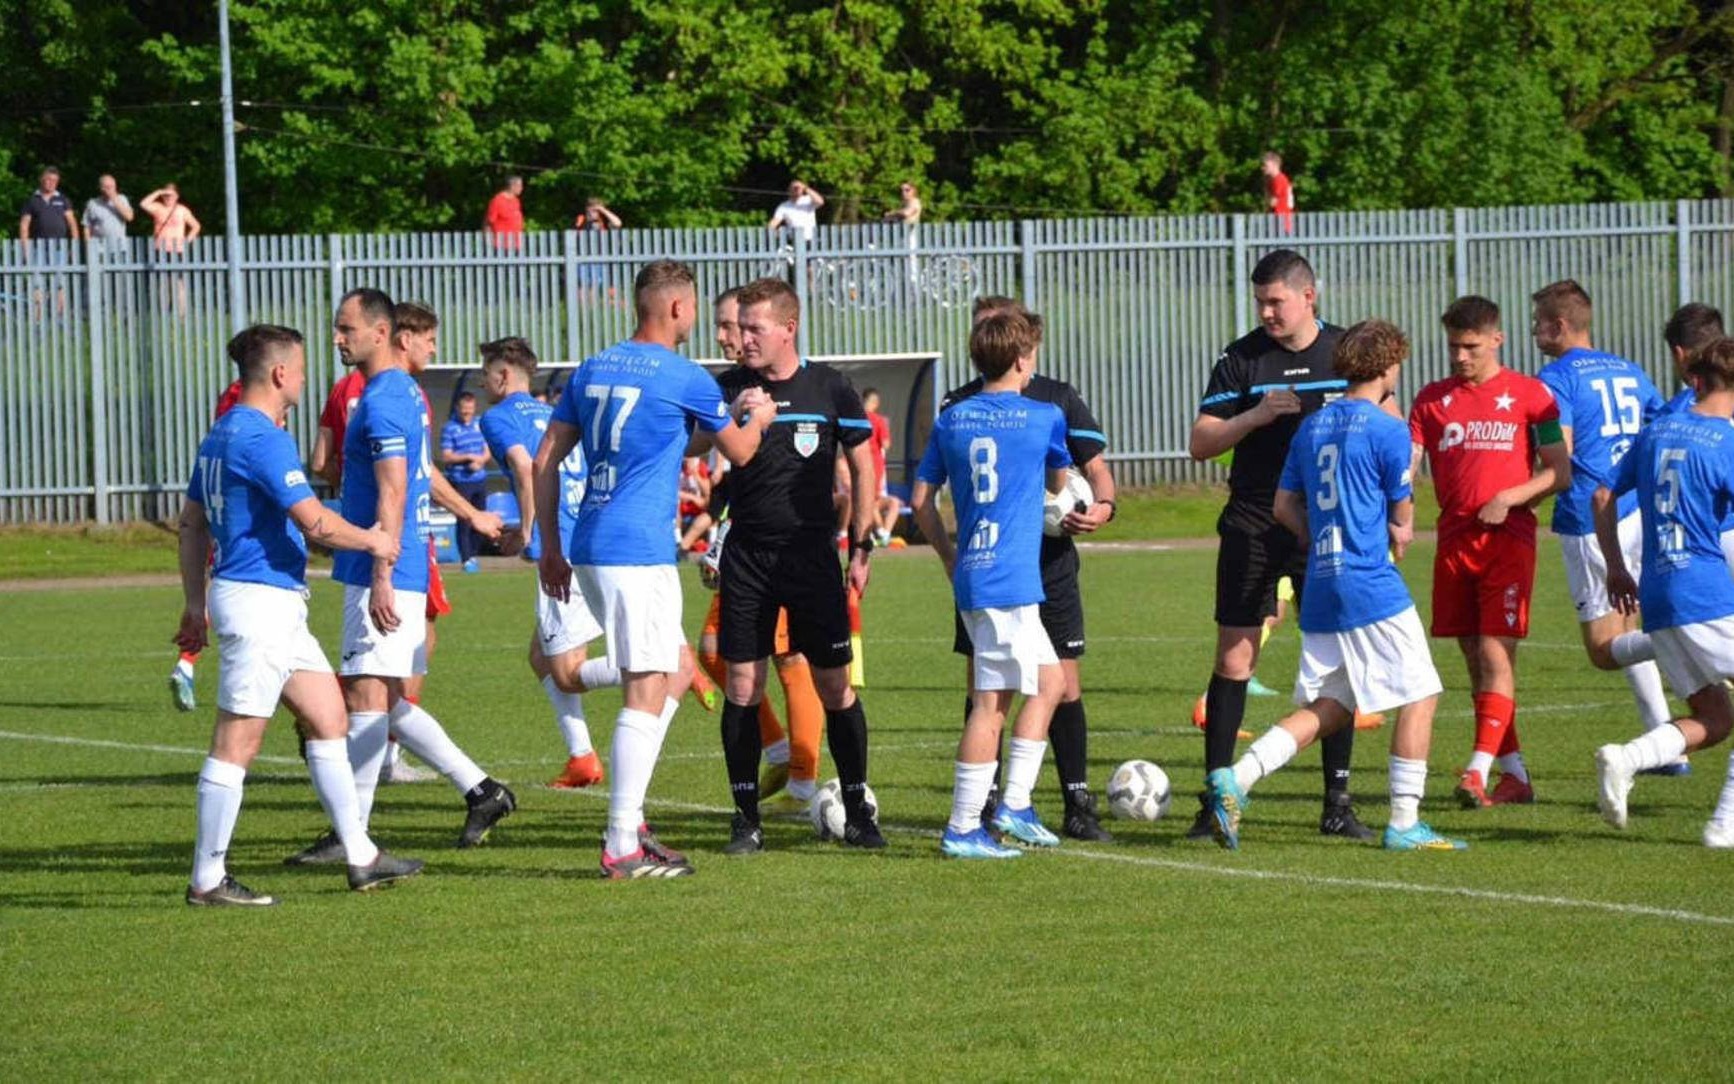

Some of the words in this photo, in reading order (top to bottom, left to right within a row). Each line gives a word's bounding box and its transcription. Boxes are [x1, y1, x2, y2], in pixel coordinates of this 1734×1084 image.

[585, 384, 642, 453] 77
[1590, 376, 1640, 437] 15
[200, 456, 224, 526] 14
[969, 436, 999, 504] 8
[1315, 443, 1339, 511] 3
[1654, 448, 1687, 515] 5
